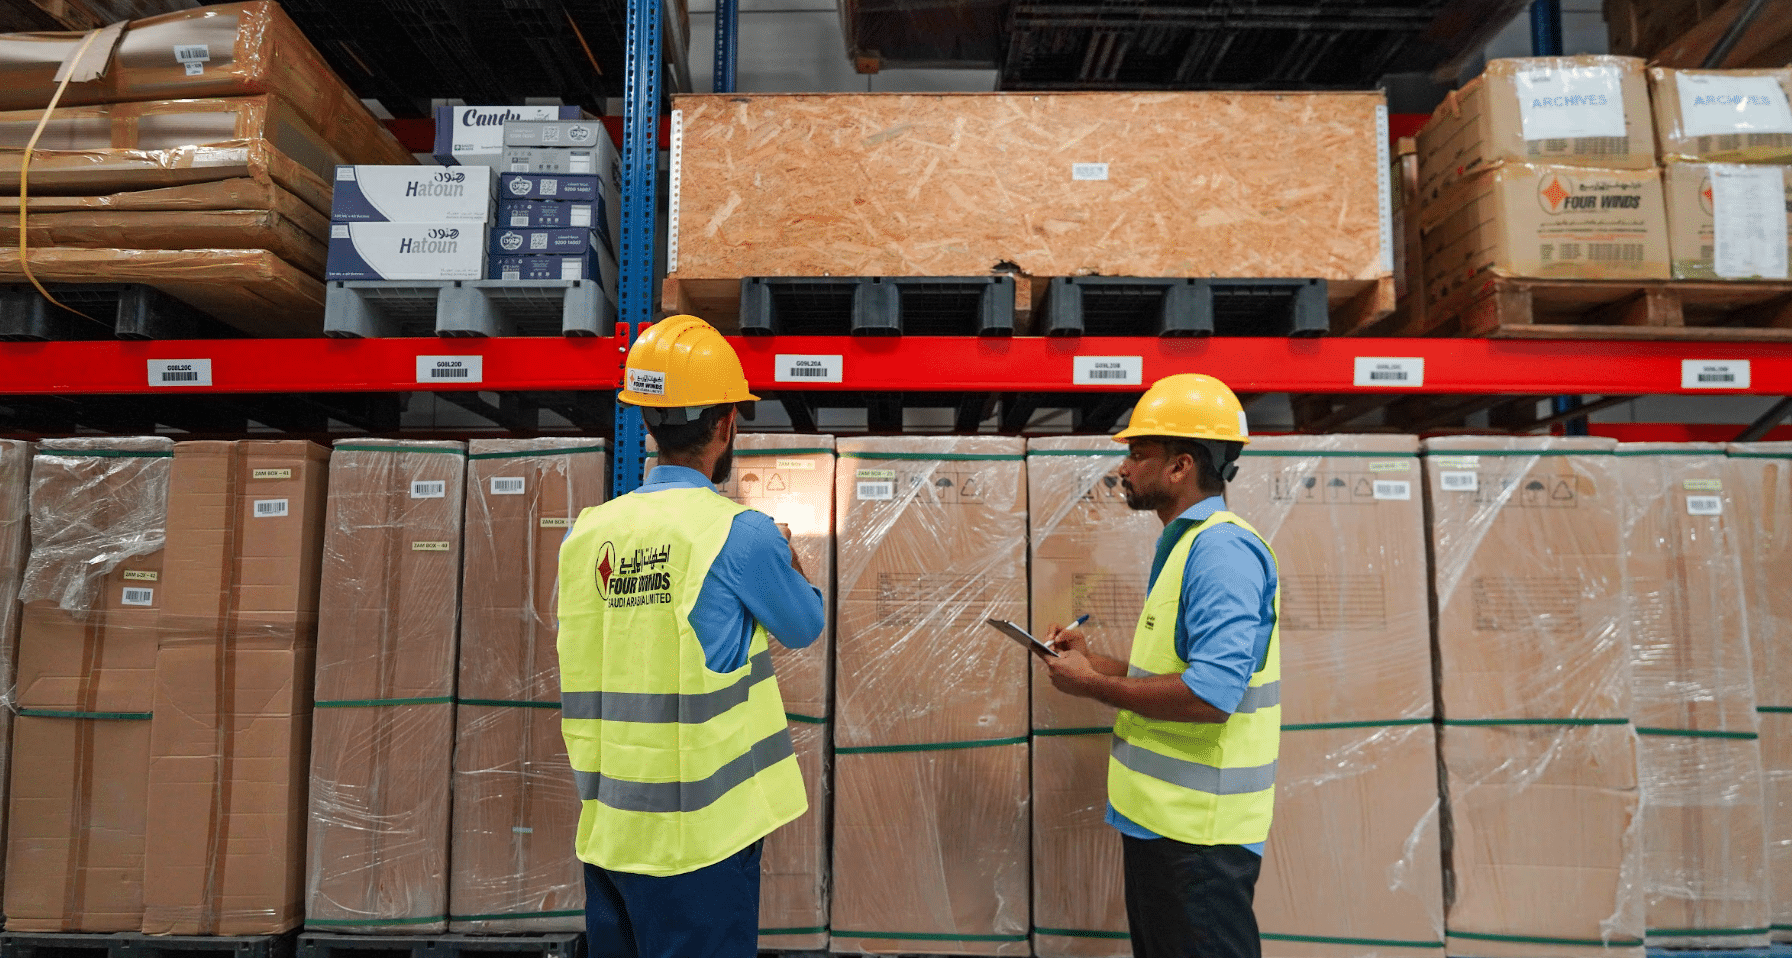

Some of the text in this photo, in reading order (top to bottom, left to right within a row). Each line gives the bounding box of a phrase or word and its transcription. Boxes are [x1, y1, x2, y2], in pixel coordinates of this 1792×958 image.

[1532, 94, 1608, 108] ARCHIVES
[405, 181, 464, 197] Hatoun
[1564, 195, 1641, 209] FOUR WINDS
[399, 237, 458, 254] Hatoun
[609, 572, 670, 595] FOUR WINDS
[608, 597, 626, 608] SAUDI
